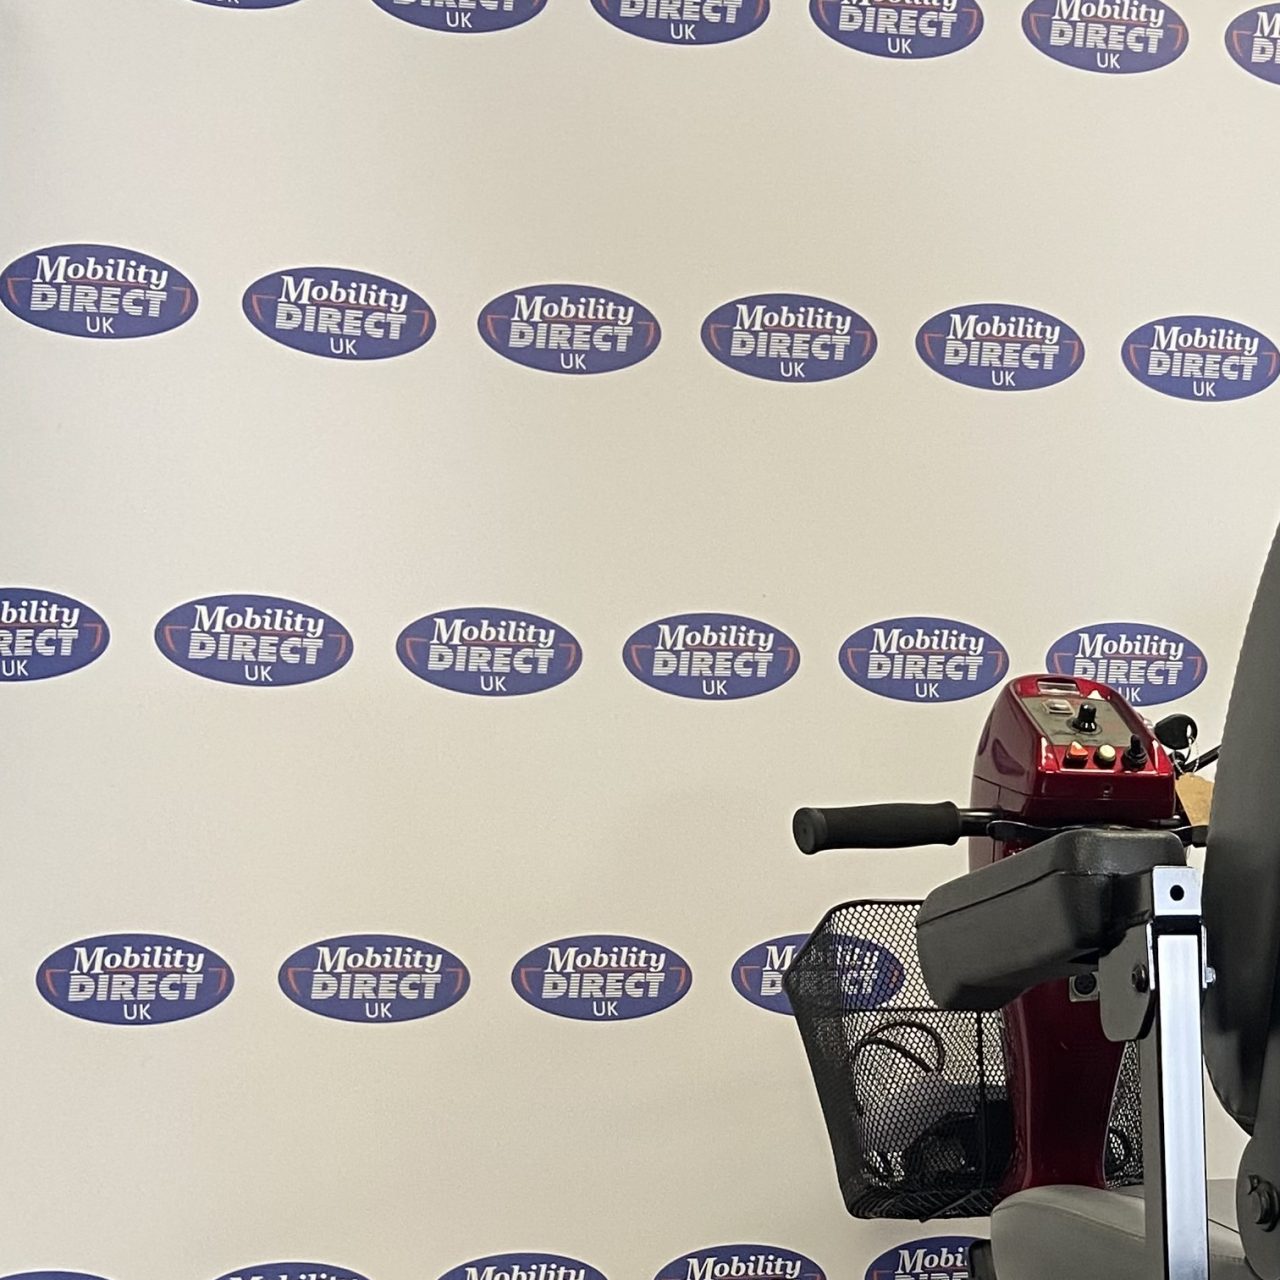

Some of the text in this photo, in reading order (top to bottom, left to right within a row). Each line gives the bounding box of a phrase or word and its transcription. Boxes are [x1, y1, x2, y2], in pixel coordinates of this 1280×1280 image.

[447, 12, 473, 28] UK
[840, 6, 957, 38] DIRECT
[1053, 0, 1165, 28] Mobility
[671, 24, 696, 40] UK
[1051, 20, 1164, 54] DIRECT
[888, 38, 912, 54] UK
[1097, 53, 1120, 69] UK
[33, 255, 168, 289] Mobility
[31, 283, 167, 317] DIRECT
[279, 276, 408, 313] Mobility
[277, 303, 407, 340] DIRECT
[512, 295, 634, 326] Mobility
[734, 304, 852, 335] Mobility
[87, 317, 115, 334] UK
[510, 322, 634, 352] DIRECT
[947, 314, 1060, 344] Mobility
[330, 338, 357, 355] UK
[732, 331, 851, 361] DIRECT
[1151, 325, 1259, 356] Mobility
[561, 353, 586, 369] UK
[945, 340, 1059, 370] DIRECT
[1149, 351, 1258, 381] DIRECT
[781, 362, 805, 378] UK
[992, 371, 1015, 386] UK
[1194, 381, 1215, 397] UK
[1, 600, 80, 629] bility
[192, 605, 325, 638] Mobility
[431, 618, 556, 648] Mobility
[656, 625, 774, 652] Mobility
[871, 629, 985, 655] Mobility
[190, 633, 324, 665] DIRECT
[429, 645, 555, 674] DIRECT
[1076, 633, 1184, 661] Mobility
[2, 660, 29, 676] UK
[245, 665, 272, 682] UK
[654, 651, 773, 677] DIRECT
[869, 654, 983, 680] DIRECT
[1073, 659, 1183, 685] DIRECT
[481, 676, 506, 691] UK
[703, 680, 727, 695] UK
[916, 683, 939, 698] UK
[71, 947, 204, 974] Mobility
[314, 947, 443, 973] Mobility
[545, 947, 666, 973] Mobility
[69, 974, 203, 1001] DIRECT
[312, 974, 442, 999] DIRECT
[543, 973, 665, 998] DIRECT
[124, 1004, 152, 1020] UK
[365, 1003, 392, 1018] UK
[593, 1001, 618, 1016] UK
[895, 1247, 968, 1274] Mobi
